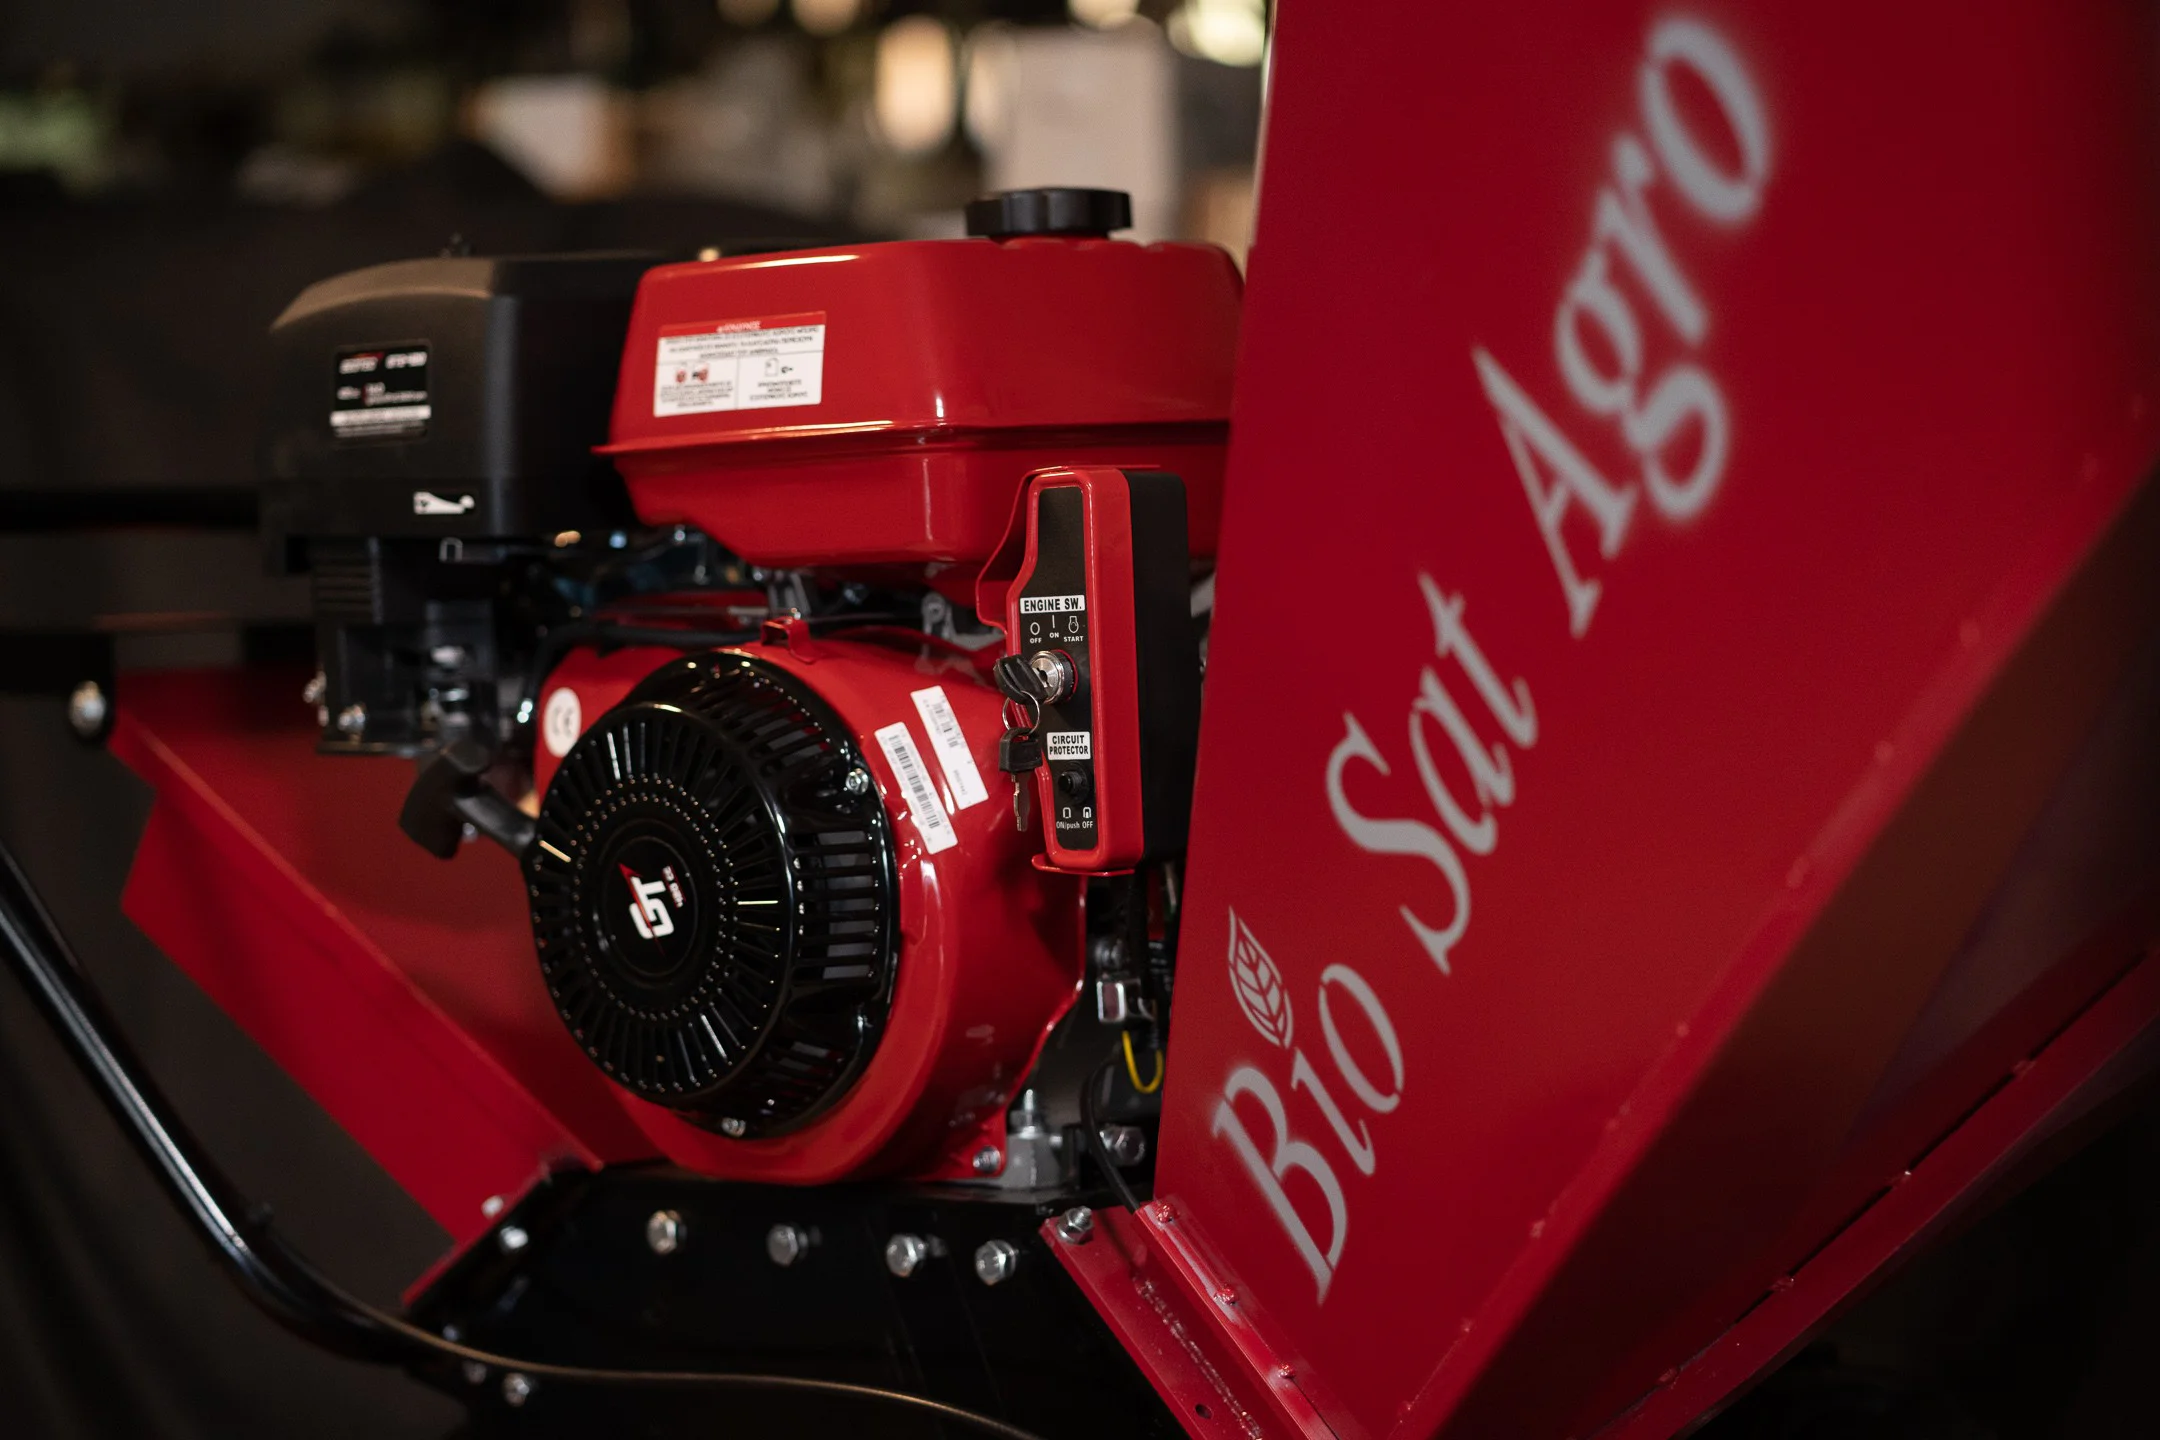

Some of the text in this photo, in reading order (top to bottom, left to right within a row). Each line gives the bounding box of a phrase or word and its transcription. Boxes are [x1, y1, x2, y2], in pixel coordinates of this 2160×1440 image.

[1023, 597, 1082, 612] ENGINE SW.
[1063, 635, 1084, 643] START
[1208, 12, 1771, 1306] Bio Sat Agro
[1052, 735, 1085, 745] CIRCUIT
[1049, 745, 1089, 755] PROTECTOR
[1056, 820, 1094, 830] ON/push OFF
